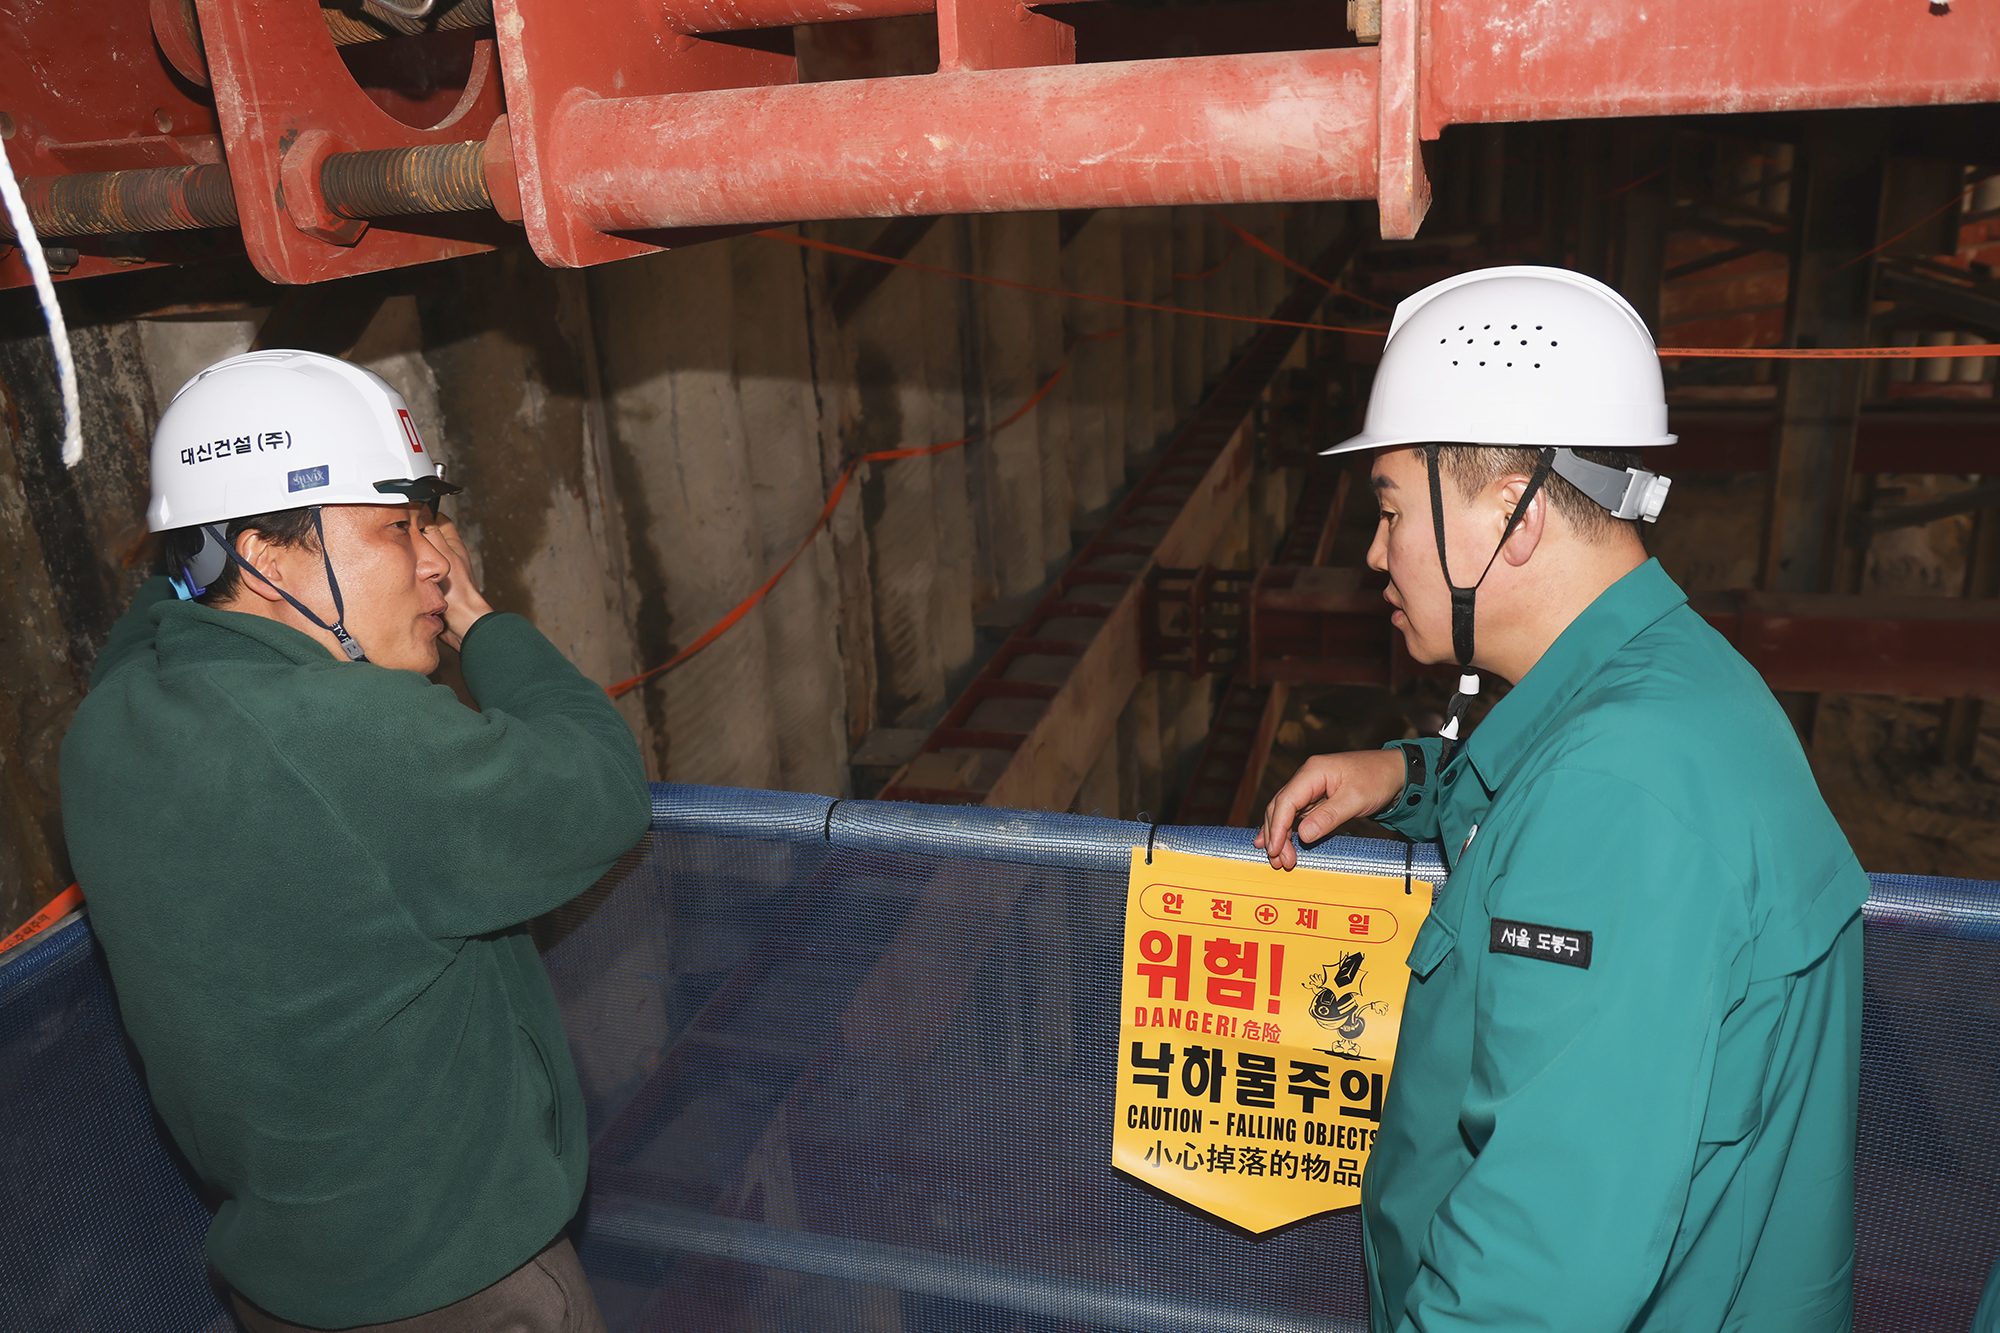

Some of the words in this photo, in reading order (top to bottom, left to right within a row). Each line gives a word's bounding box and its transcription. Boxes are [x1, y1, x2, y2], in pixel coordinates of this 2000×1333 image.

[180, 435, 252, 466] 대신건설
[257, 430, 292, 452] (주)
[1501, 927, 1531, 949] 서울
[1536, 933, 1580, 957] 도봉구
[1137, 930, 1285, 1015] 위험!
[1134, 1006, 1238, 1037] DANGER!
[1241, 1019, 1282, 1044] 危险
[1131, 1041, 1383, 1123] 낙하물주의
[1127, 1104, 1202, 1133] CAUTION
[1226, 1112, 1297, 1143] FALLING
[1143, 1140, 1361, 1188] 小心掉落的物品
